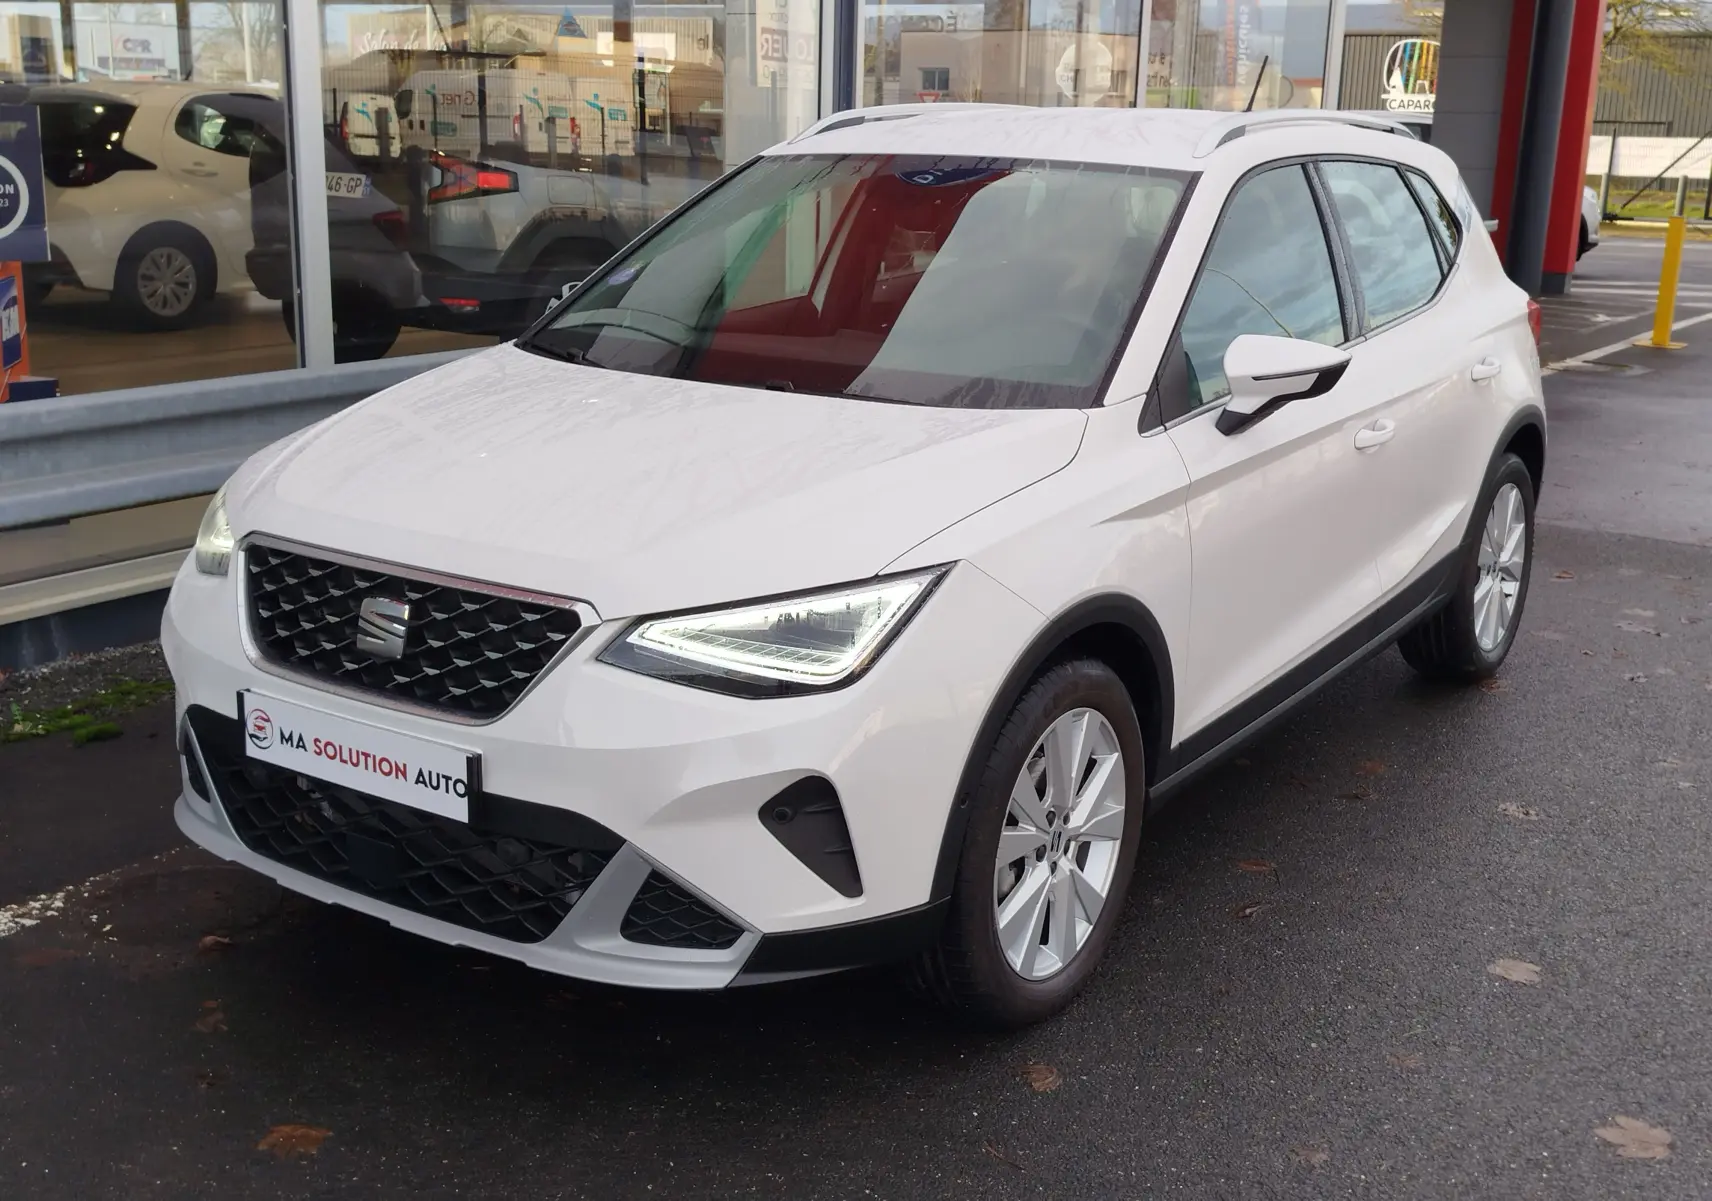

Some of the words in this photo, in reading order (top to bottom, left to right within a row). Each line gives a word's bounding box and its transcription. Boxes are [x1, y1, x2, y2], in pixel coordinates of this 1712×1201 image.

[279, 726, 308, 752] MA
[313, 736, 408, 783] SOLUTION
[414, 767, 468, 799] AUTO
